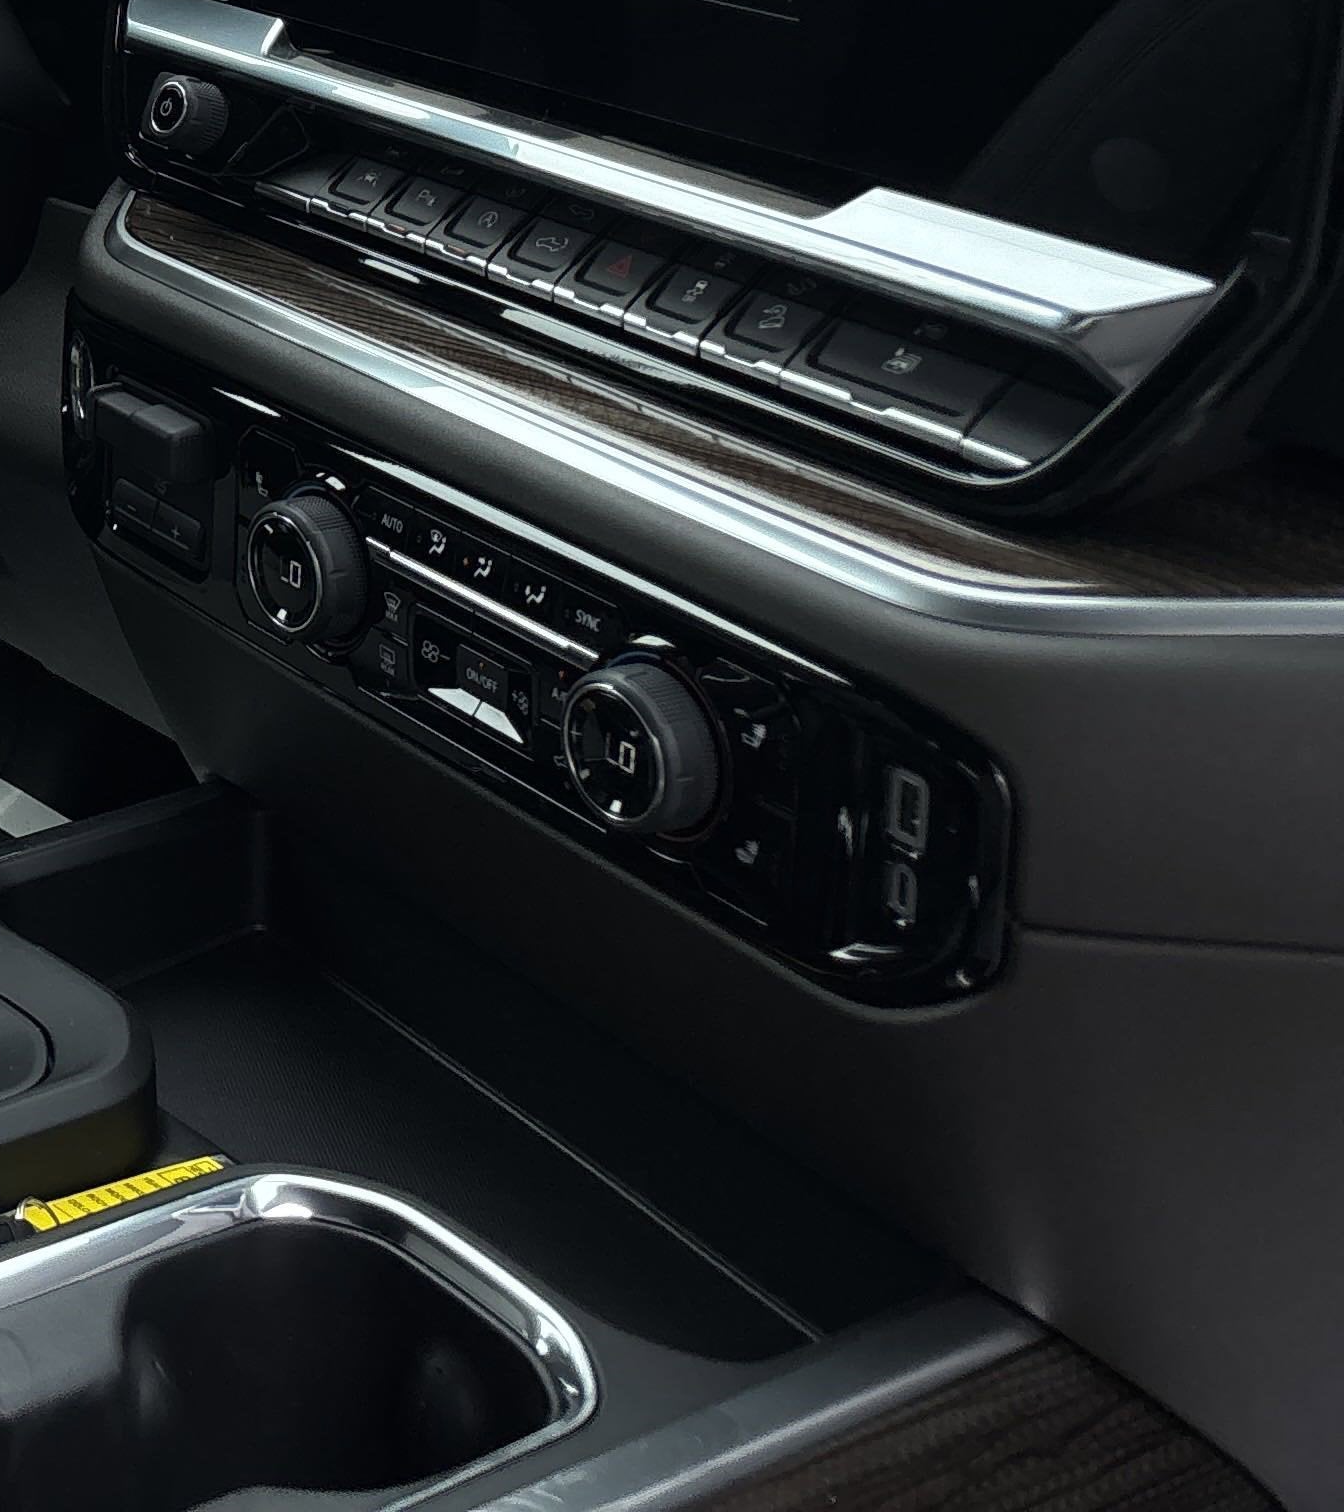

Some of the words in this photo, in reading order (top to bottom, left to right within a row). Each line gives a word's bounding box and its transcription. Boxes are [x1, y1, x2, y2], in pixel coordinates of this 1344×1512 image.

[381, 514, 404, 533] AUTO
[575, 609, 601, 632] SYNC
[466, 668, 498, 693] ON/OFF
